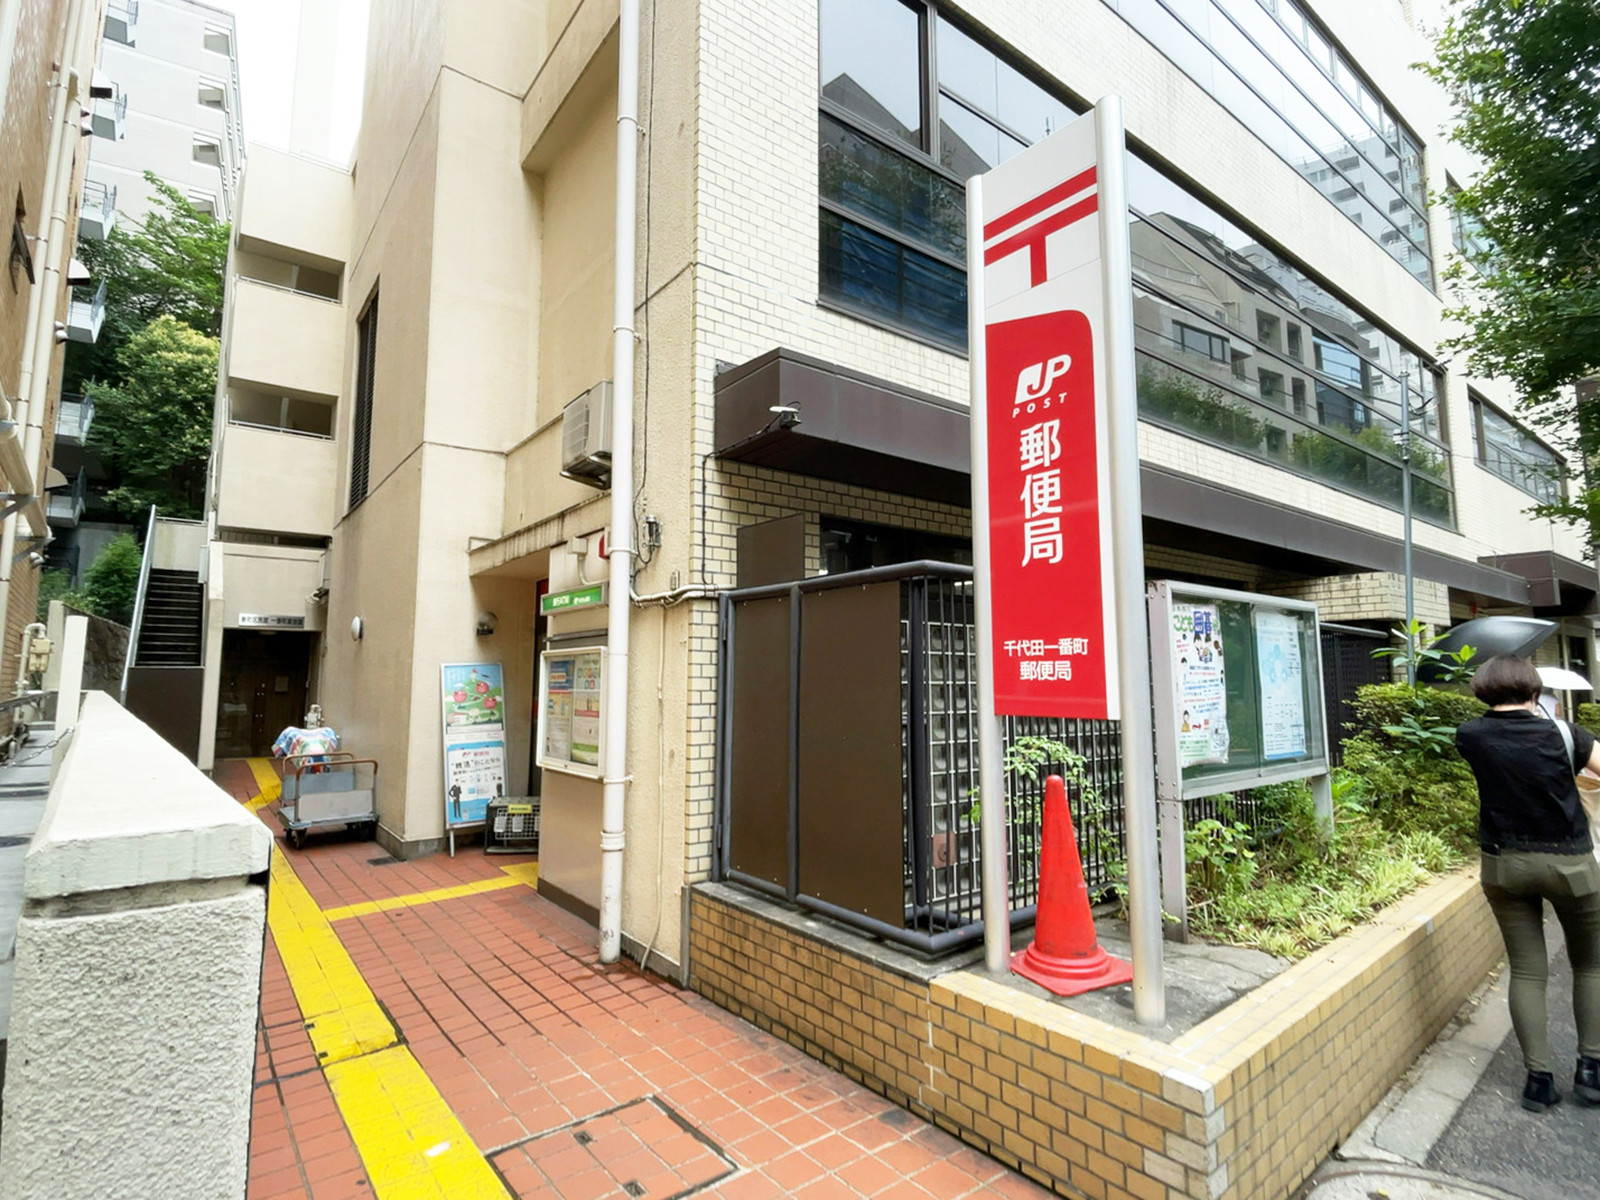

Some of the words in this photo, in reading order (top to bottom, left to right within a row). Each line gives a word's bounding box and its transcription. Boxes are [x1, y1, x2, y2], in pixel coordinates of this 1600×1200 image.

[1014, 353, 1072, 405] JP
[1012, 392, 1068, 418] POST
[1019, 418, 1063, 568] 郵便局
[1003, 638, 1089, 657] 千代田一番町
[1020, 660, 1072, 681] 郵便局
